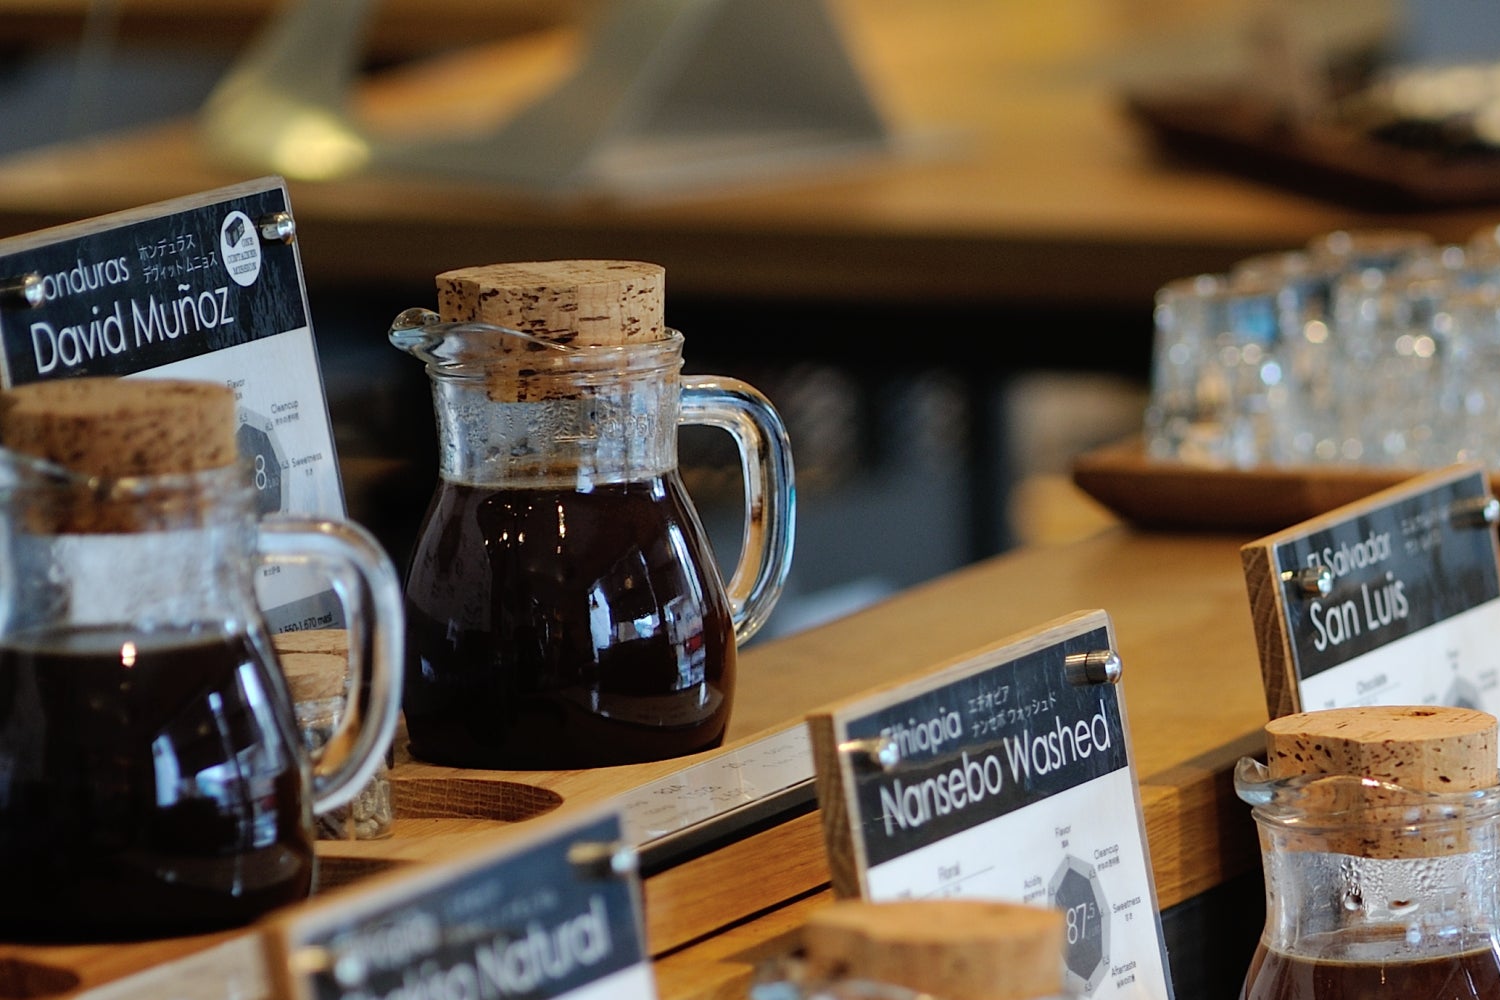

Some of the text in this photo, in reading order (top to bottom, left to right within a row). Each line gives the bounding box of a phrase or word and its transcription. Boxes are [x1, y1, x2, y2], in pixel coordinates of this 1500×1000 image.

[42, 255, 130, 300] onduras
[31, 284, 234, 374] David Muñoz
[1323, 529, 1392, 578] Salvador
[1310, 570, 1410, 652] San Luis
[879, 750, 1002, 838] Nansebo
[1004, 698, 1111, 785] Washed
